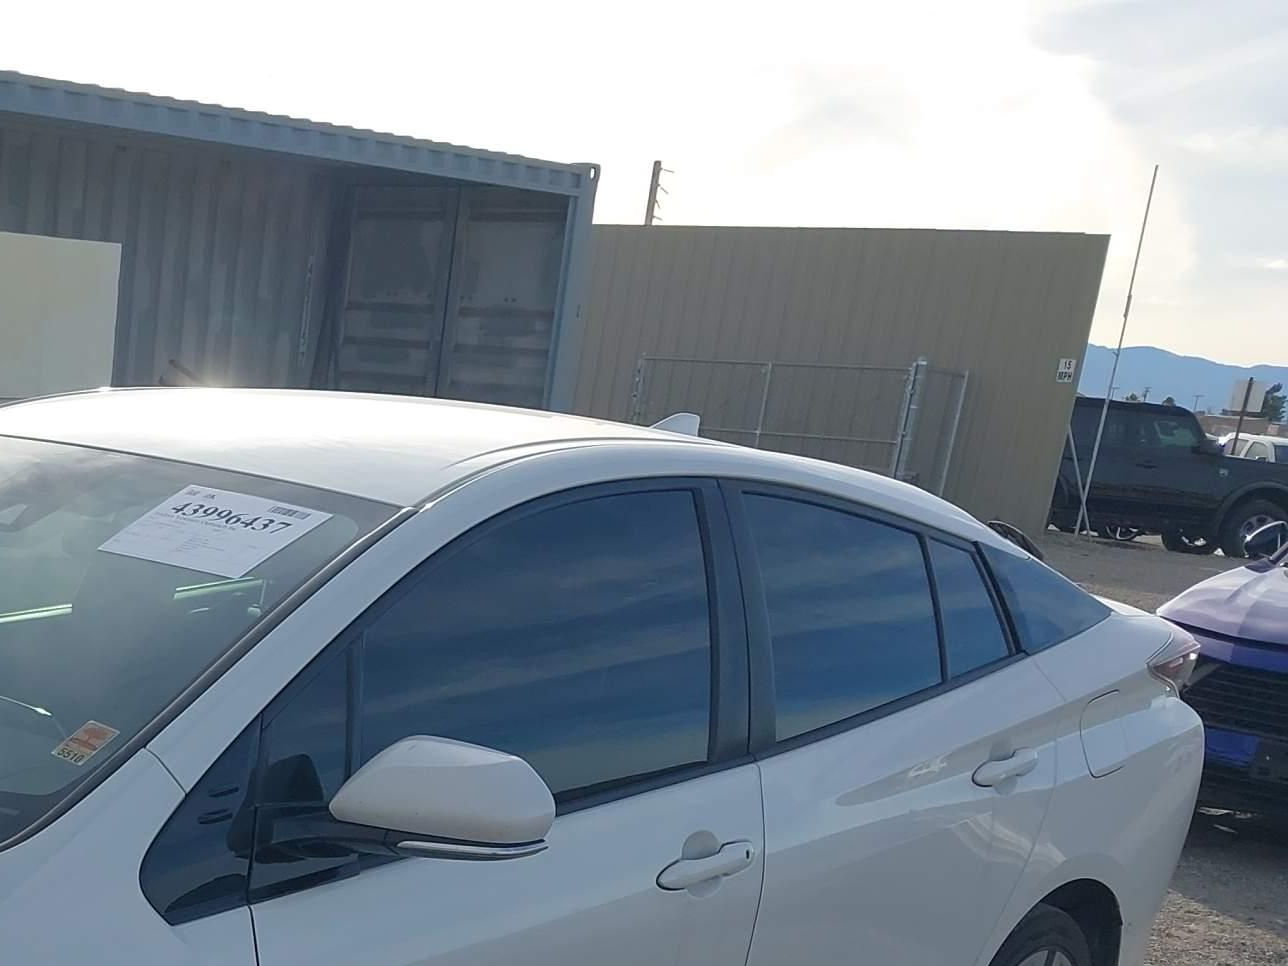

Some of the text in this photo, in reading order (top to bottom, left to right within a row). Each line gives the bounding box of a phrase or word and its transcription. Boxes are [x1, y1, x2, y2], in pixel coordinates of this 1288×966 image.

[1064, 360, 1073, 370] 15
[1058, 371, 1073, 381] MPH
[171, 502, 293, 534] 43996437
